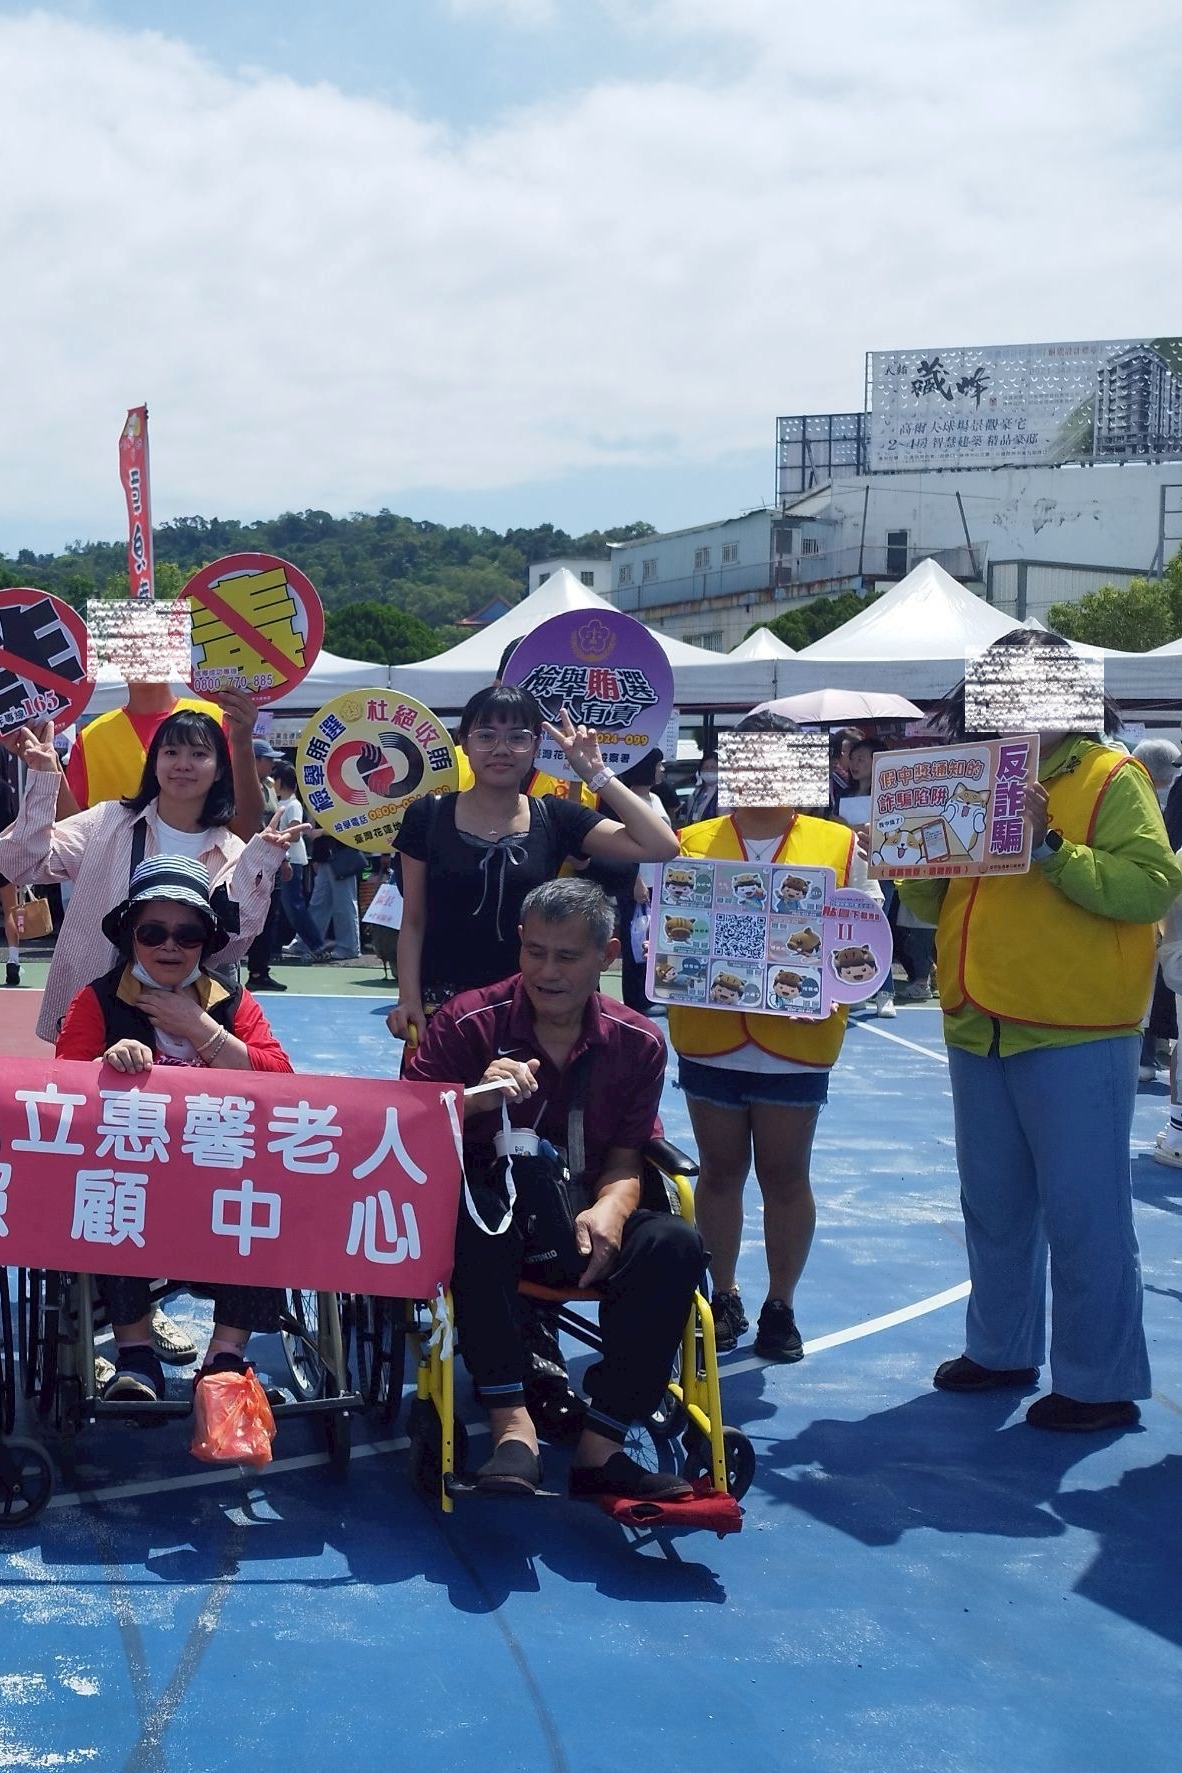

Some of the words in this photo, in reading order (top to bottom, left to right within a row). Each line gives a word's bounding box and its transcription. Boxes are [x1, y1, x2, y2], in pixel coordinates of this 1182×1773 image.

[194, 676, 221, 691] 0800
[253, 674, 273, 687] 885
[519, 664, 659, 704] 檢舉賄選
[22, 689, 60, 718] 165
[367, 699, 453, 773] 杜絕收賄
[304, 714, 347, 814] 檢舉賄選
[879, 759, 985, 791] 假中獎通知的
[877, 785, 950, 815] 詐騙陷阱
[989, 743, 1030, 856] 反詐騙
